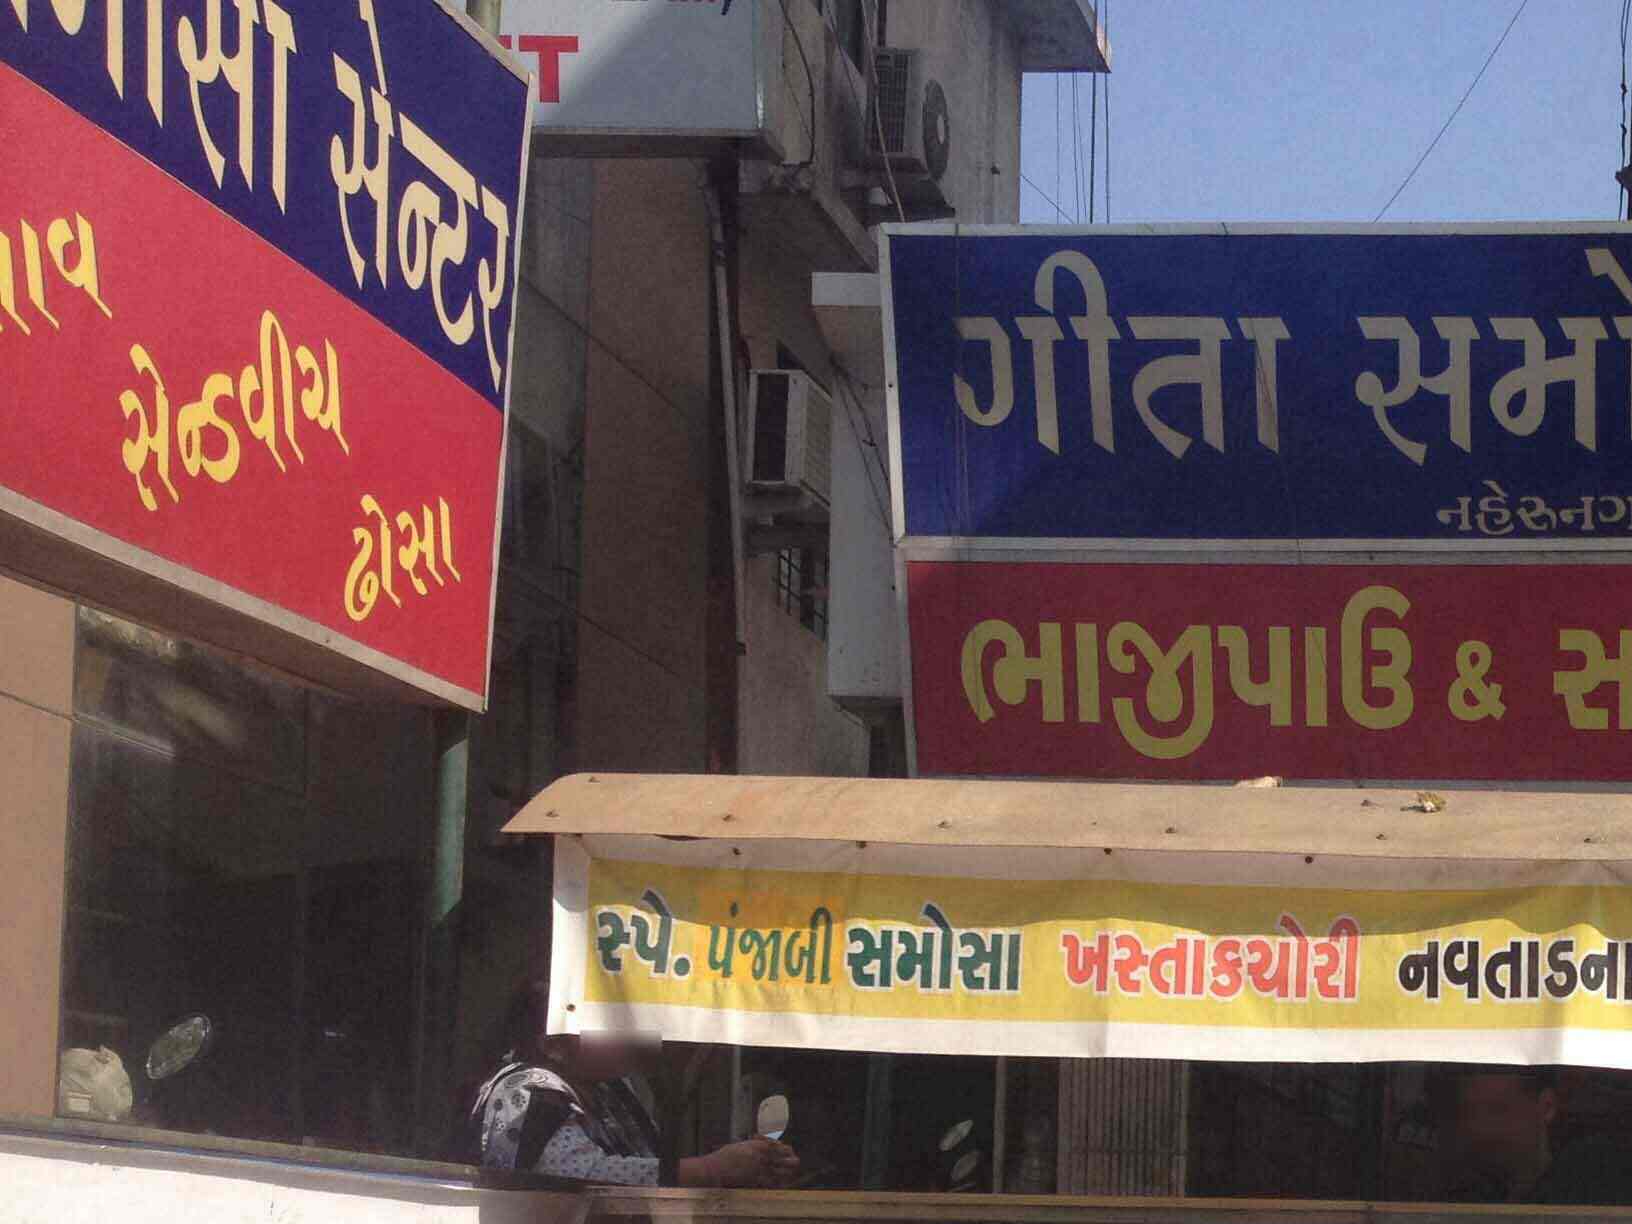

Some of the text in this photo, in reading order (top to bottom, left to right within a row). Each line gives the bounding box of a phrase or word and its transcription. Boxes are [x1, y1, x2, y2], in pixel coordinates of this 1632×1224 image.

[330, 0, 511, 394] સેન્ટર
[953, 249, 1292, 460] ગીતા
[343, 493, 462, 623] ઢોસા
[960, 585, 1414, 760] ભાજીપાઉ
[1447, 639, 1507, 721] &
[706, 901, 833, 986] પંજાબી
[846, 902, 1021, 991] સમોસા
